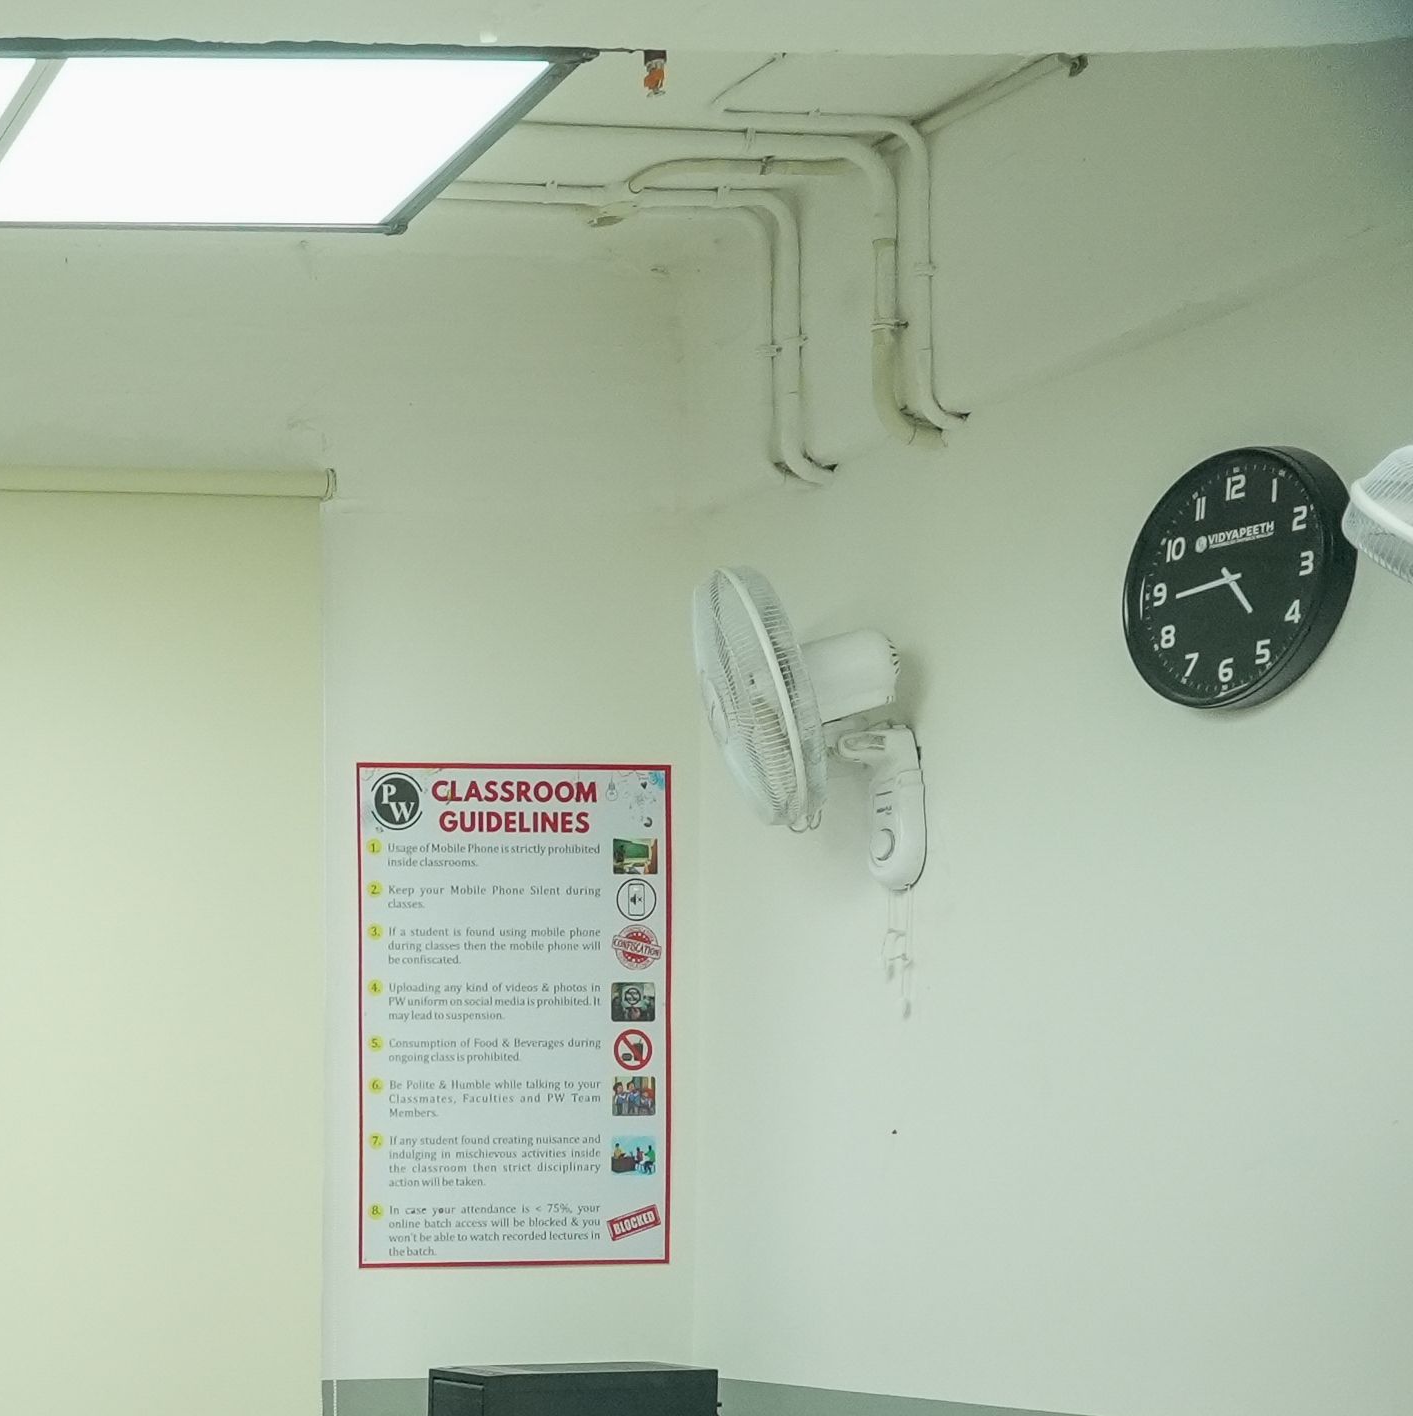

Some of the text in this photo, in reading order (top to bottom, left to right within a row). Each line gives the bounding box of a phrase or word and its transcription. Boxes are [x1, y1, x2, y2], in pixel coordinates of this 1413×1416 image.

[1225, 474, 1246, 501] 12
[1271, 478, 1277, 503] 1
[1195, 497, 1206, 521] 11
[1292, 505, 1307, 532] 2
[1208, 520, 1275, 545] VIDYAPEETH
[1165, 537, 1186, 563] 10
[1299, 550, 1314, 576] 3
[1153, 582, 1167, 607] 9
[1284, 599, 1301, 623] 4
[1160, 625, 1175, 650] 8
[1255, 639, 1271, 664] 5
[1184, 652, 1199, 678] 7
[1218, 658, 1233, 683] 6
[432, 780, 597, 803] CLASSROOM
[439, 811, 590, 832] GUIDELINES
[388, 843, 417, 854] Usage
[420, 844, 431, 853] of
[432, 844, 465, 853] Mobile
[468, 844, 498, 853] Phone
[501, 844, 509, 853] is
[511, 844, 545, 855] strictly
[548, 844, 600, 855] prohibited
[388, 858, 418, 867] inside
[388, 886, 414, 897] Keep
[420, 887, 444, 897] your
[450, 886, 486, 895] Mobile
[492, 886, 524, 895] Phone
[531, 886, 560, 895] Silent
[566, 886, 601, 897] during
[388, 928, 396, 936] If
[411, 928, 448, 937] student
[453, 928, 461, 936] is
[466, 928, 495, 936] found
[500, 928, 526, 939] using
[531, 928, 565, 936] mobile
[570, 928, 600, 939] phone
[388, 942, 601, 952] during classes then the mobile phone will
[388, 956, 400, 964] be
[389, 984, 440, 994] Uploading
[444, 986, 461, 994] any
[466, 983, 488, 992] kind
[492, 983, 501, 992] of
[505, 983, 537, 992] videos
[554, 984, 587, 994] photos
[592, 984, 600, 992] in
[388, 997, 406, 1006] PW
[408, 997, 449, 1006] uniform
[464, 997, 492, 1006] social
[495, 997, 525, 1006] media
[527, 997, 535, 1006] is
[593, 997, 600, 1005] It
[388, 1013, 408, 1021] may
[411, 1011, 432, 1020] lead
[434, 1012, 444, 1020] to
[613, 1210, 655, 1235] BLOCKED
